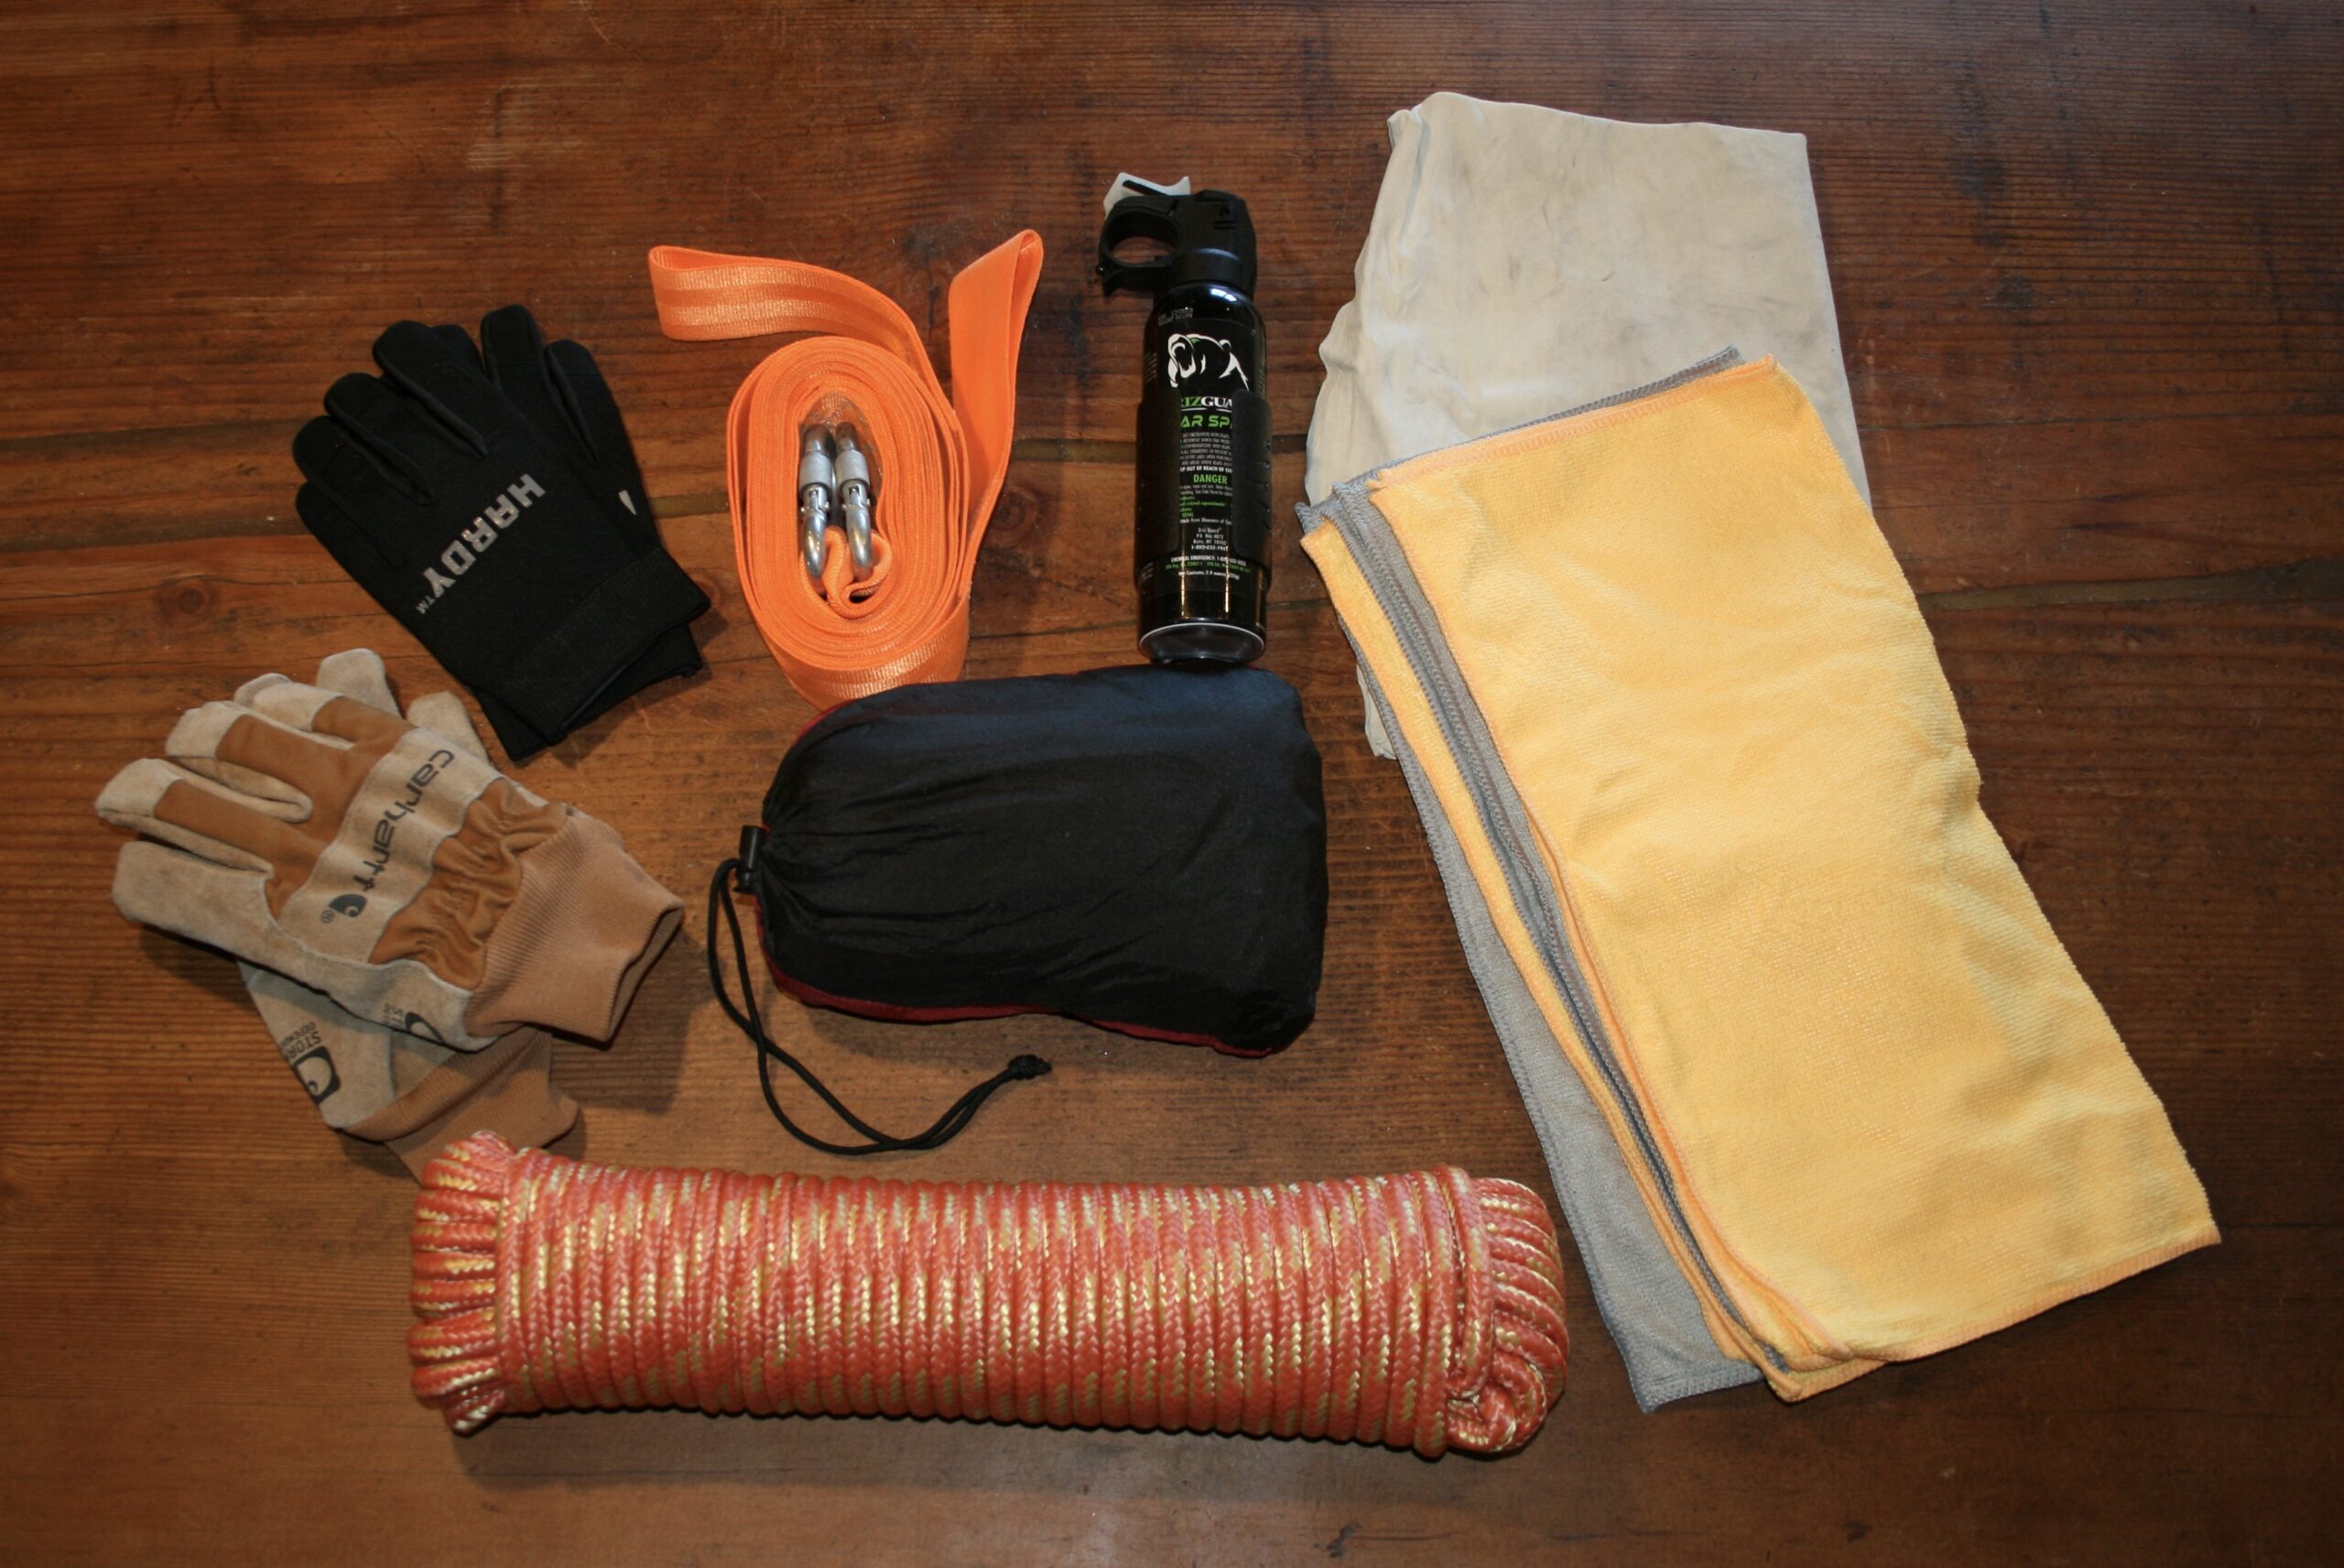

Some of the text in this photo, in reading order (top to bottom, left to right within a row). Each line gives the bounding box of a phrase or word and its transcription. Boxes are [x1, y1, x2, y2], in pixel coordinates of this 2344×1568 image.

[1181, 396, 1232, 408] IZGUA
[1193, 474, 1228, 484] DANGER
[352, 749, 455, 892] carhartt
[283, 1030, 322, 1060] STOR
